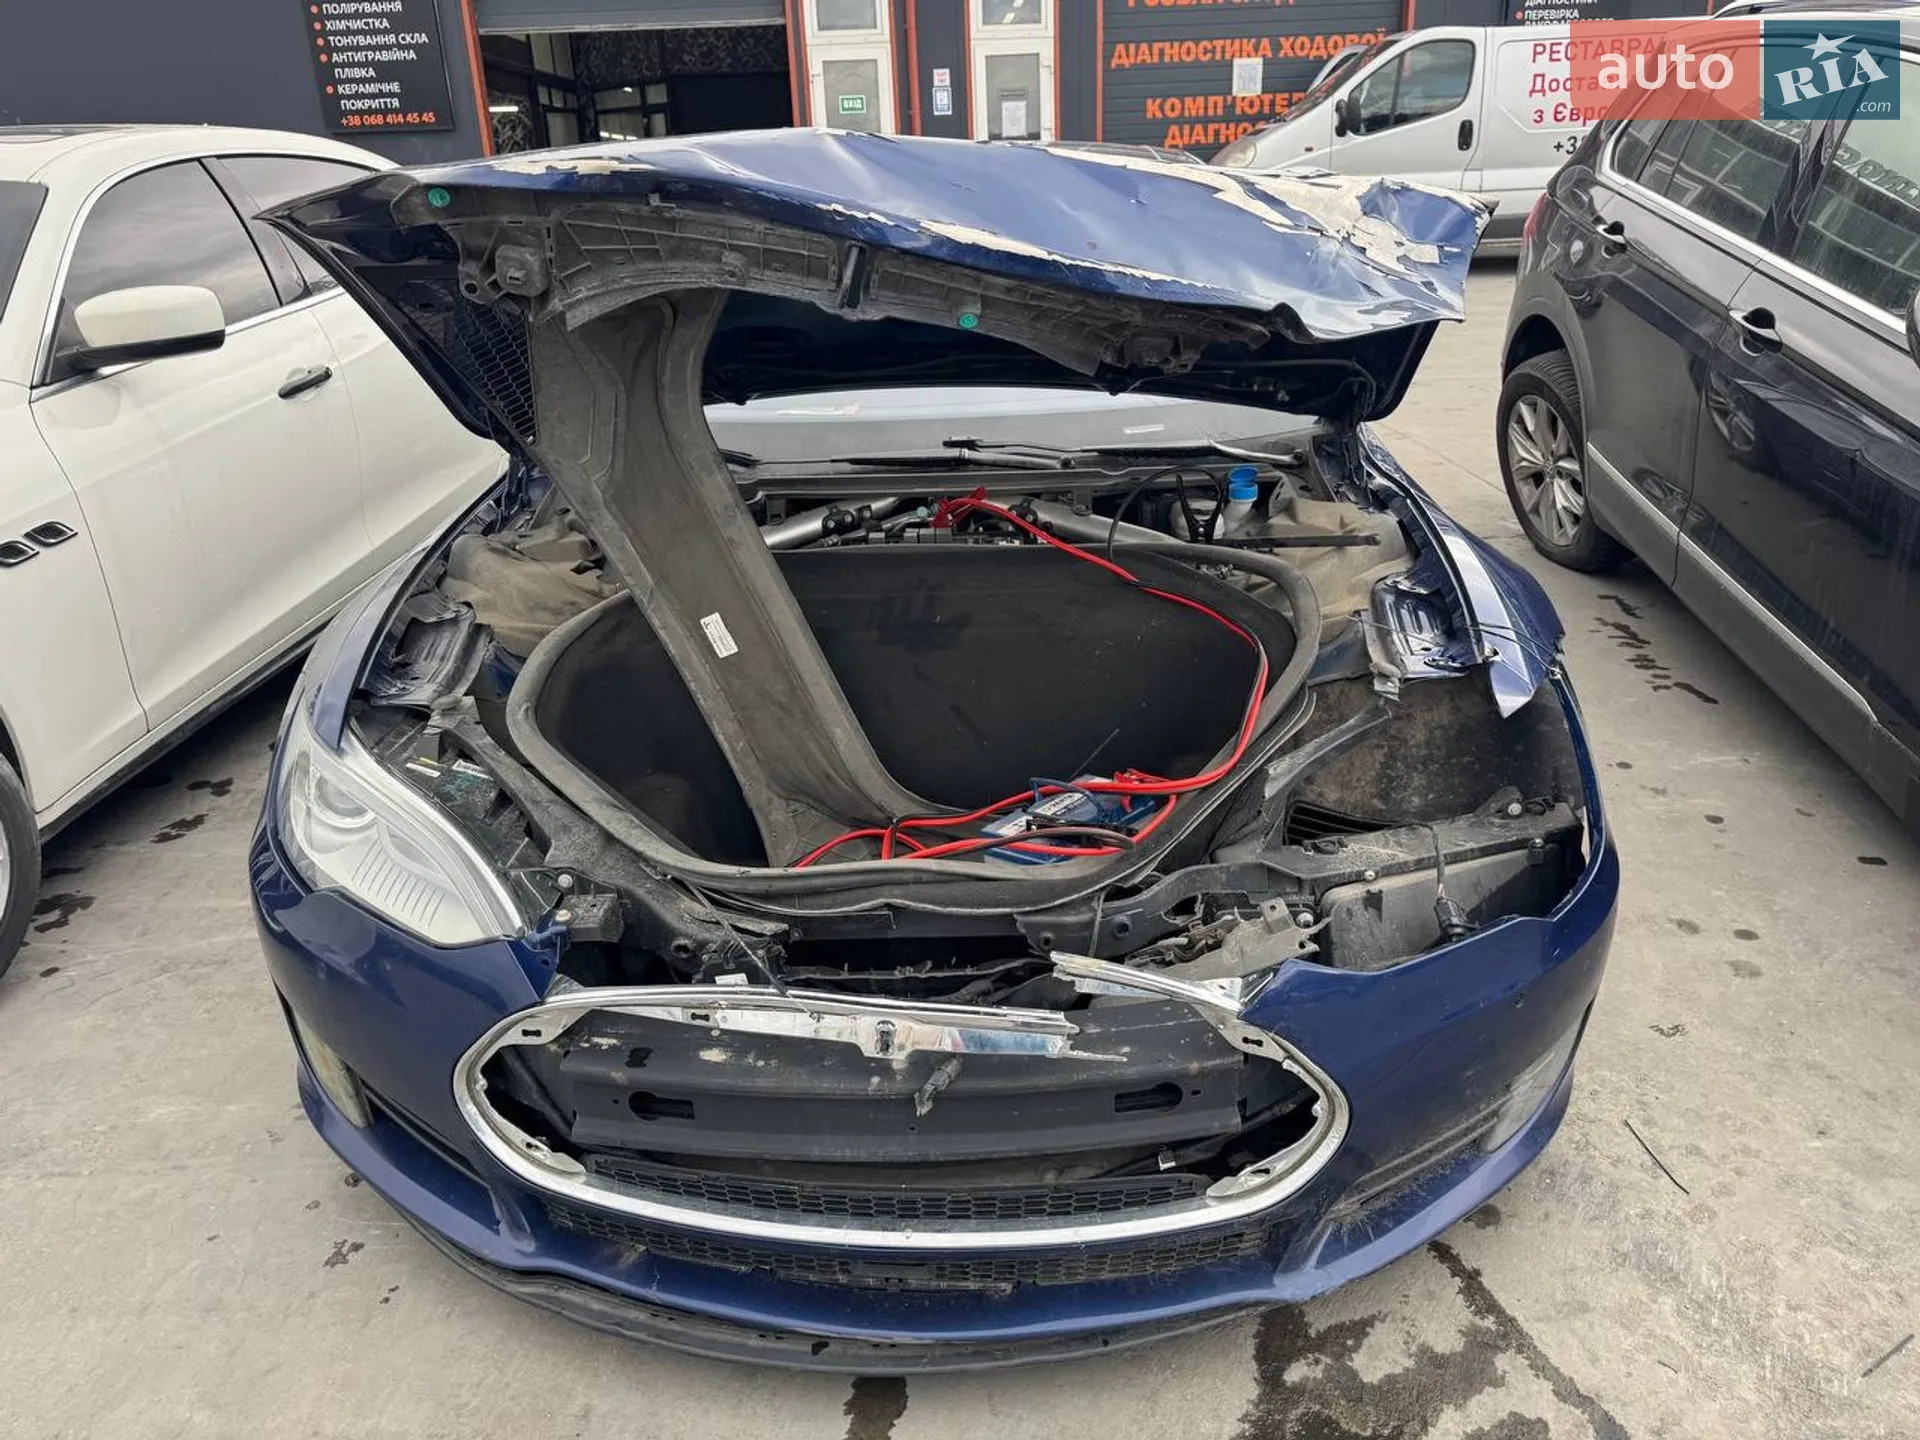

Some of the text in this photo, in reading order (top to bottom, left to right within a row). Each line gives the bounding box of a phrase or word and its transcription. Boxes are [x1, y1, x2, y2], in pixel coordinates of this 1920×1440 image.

[322, 2, 402, 14] ПОЛІРУВАННЯ
[1524, 9, 1579, 20] ПЕРЕВІРКА
[325, 18, 390, 31] ХІМЧИСТКА
[328, 33, 429, 47] ТОНУВАННЯ СКЛА
[331, 48, 417, 63] АНТИГРАВІЙНА
[1110, 38, 1273, 69] ДІАГНОСТИКА
[1531, 38, 1660, 63] РЕСТАВРА
[334, 67, 376, 79] ПЛІВКА
[337, 82, 401, 95] КЕРАМІЧНЕ
[1528, 73, 1611, 97] Доста
[340, 98, 400, 110] ПОКРИТТЯ
[341, 112, 435, 126] +38 068 414 45 45
[1532, 102, 1609, 127] з Євро
